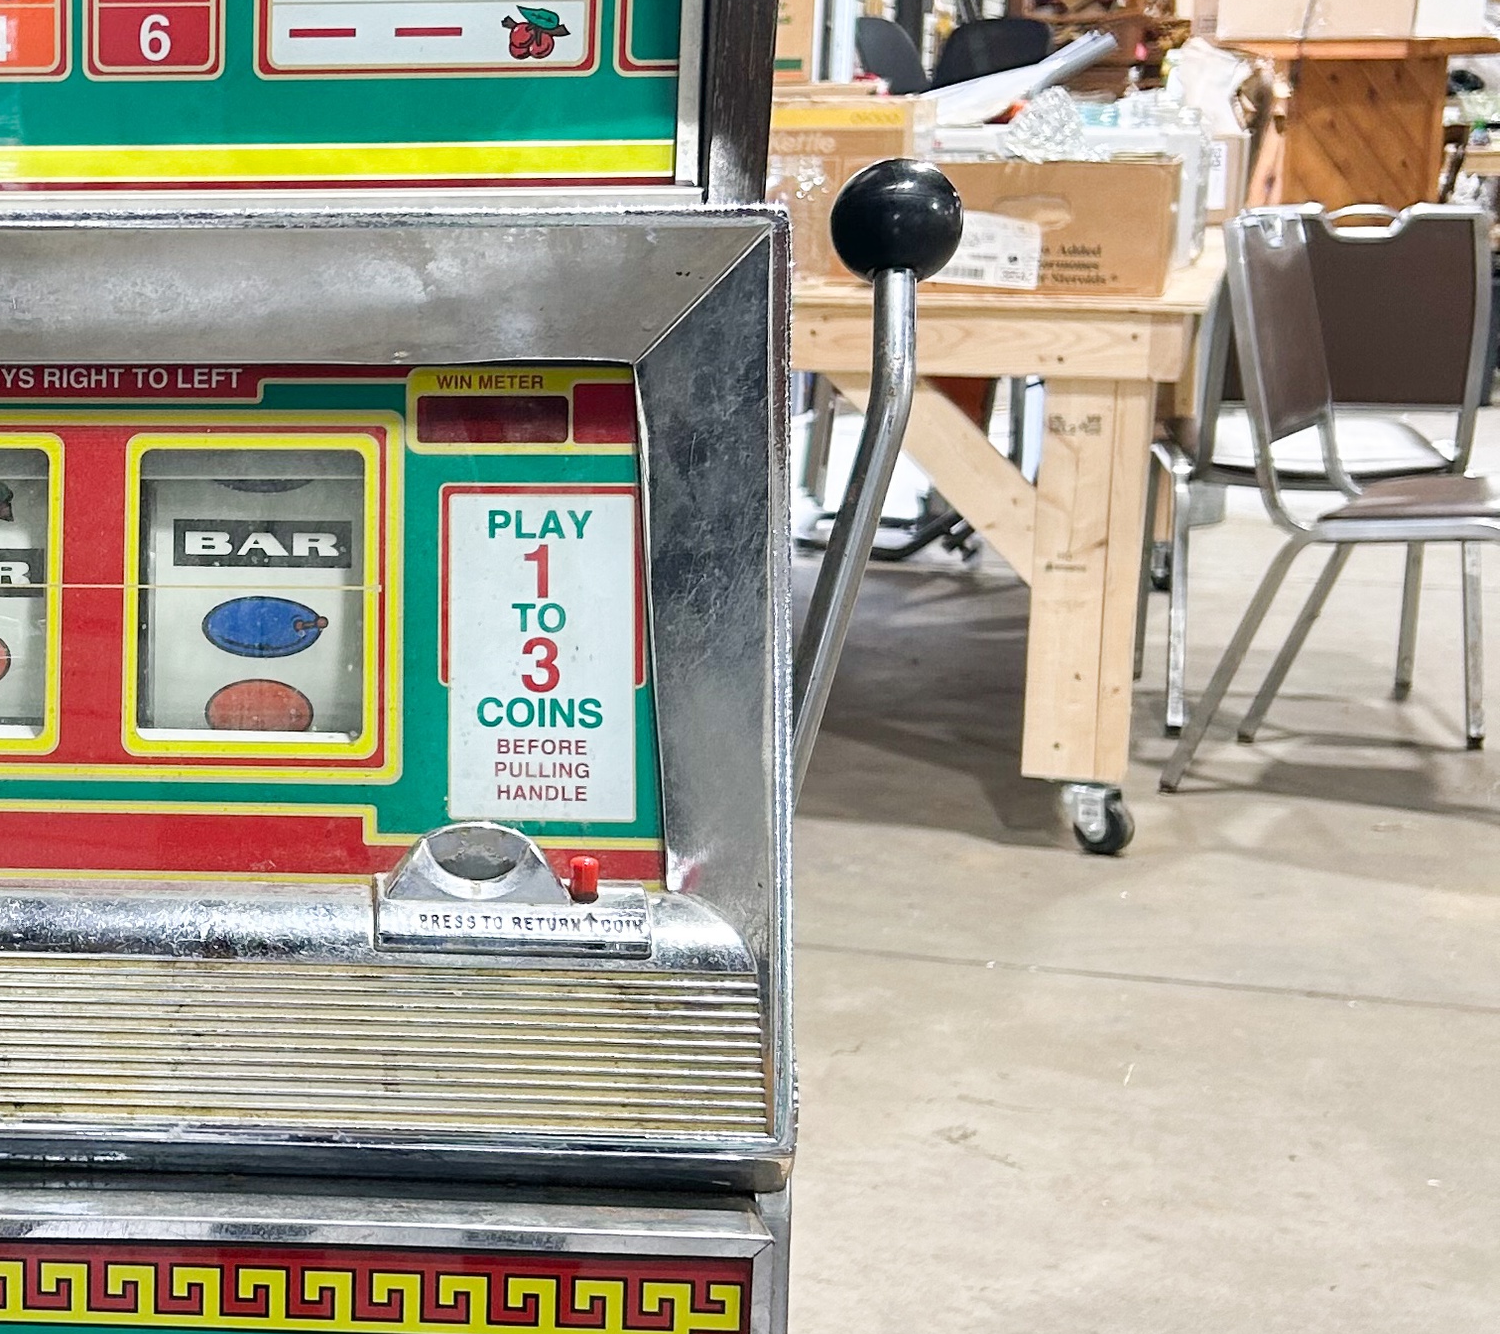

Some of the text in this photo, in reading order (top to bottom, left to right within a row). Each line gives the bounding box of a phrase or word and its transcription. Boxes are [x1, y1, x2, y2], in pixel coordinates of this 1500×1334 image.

[139, 14, 171, 62] 6
[43, 368, 128, 390] RIGHT
[134, 368, 170, 389] TO
[176, 368, 242, 389] LEFT
[436, 374, 544, 390] WIN METER
[487, 511, 593, 540] PLAY
[184, 532, 339, 557] BAR
[523, 545, 550, 598] 1
[511, 603, 567, 632] TO
[521, 638, 561, 693] 3
[476, 697, 602, 728] COINS
[496, 739, 587, 756] BEFORE
[494, 762, 590, 780] PULLING
[496, 785, 587, 802] HANDLE
[419, 913, 643, 934] PRESS TO RETURN COIN
